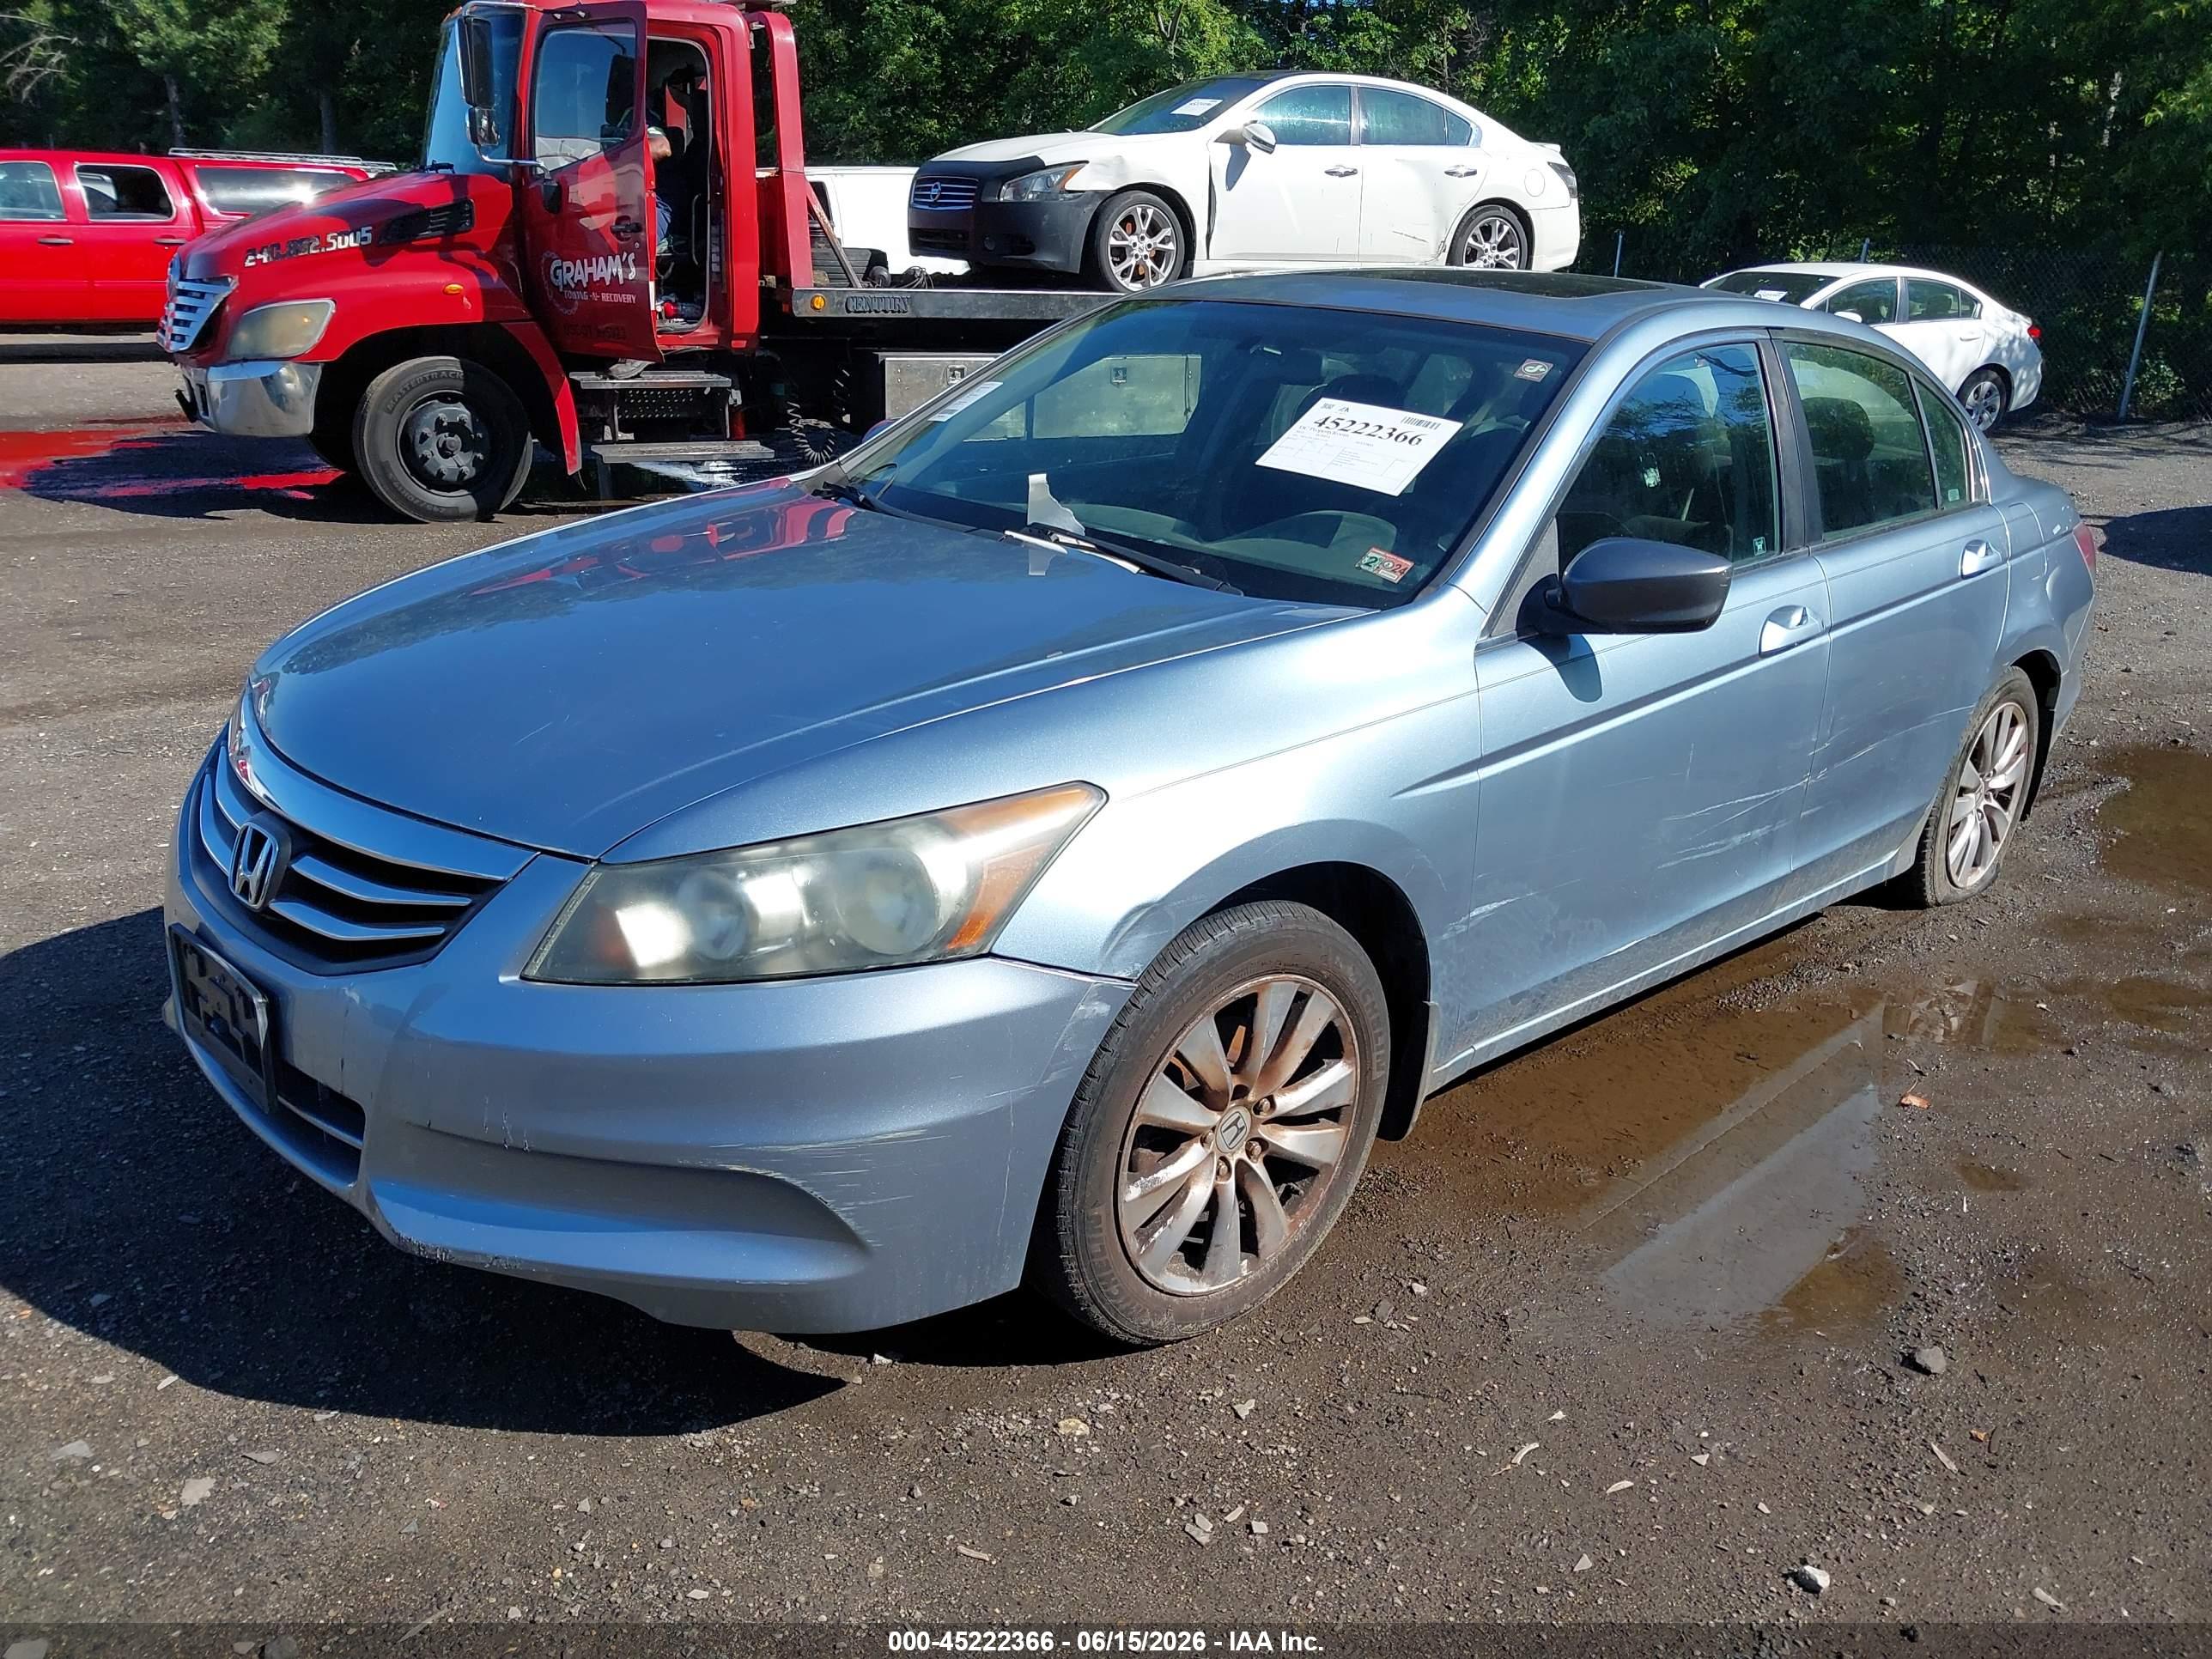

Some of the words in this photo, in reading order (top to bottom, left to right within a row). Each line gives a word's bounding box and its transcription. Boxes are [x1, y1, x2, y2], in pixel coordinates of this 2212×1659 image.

[550, 252, 636, 292] GRAHAM'S
[601, 292, 636, 304] RECOVERY
[845, 295, 911, 313] CENTURY
[1313, 416, 1426, 447] 45222366
[1364, 556, 1378, 568] 2
